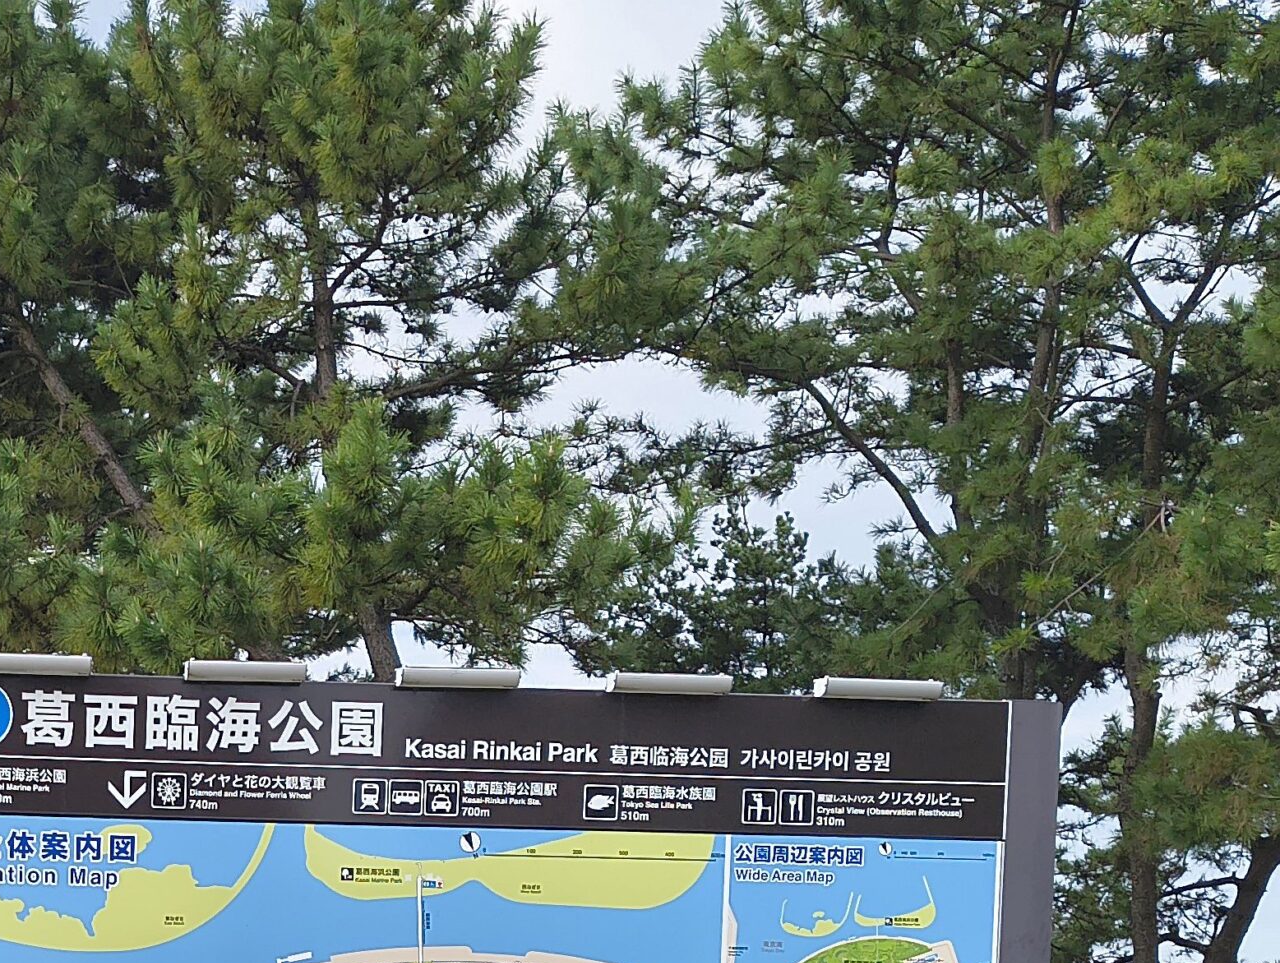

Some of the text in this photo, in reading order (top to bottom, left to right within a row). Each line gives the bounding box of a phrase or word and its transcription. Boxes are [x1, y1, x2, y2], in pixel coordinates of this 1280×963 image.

[21, 689, 384, 757] 葛西臨海公園
[404, 738, 597, 763] Kasai Rinkai Park
[609, 744, 729, 769] 葛西临海公园
[741, 748, 891, 773] 가사이린카이 공원
[8, 784, 37, 795] Marine
[39, 786, 51, 796] Park
[191, 773, 325, 791] ダイヤと花の大観覧車
[428, 783, 455, 793] TAXI
[462, 780, 558, 796] 葛西臨海公園駅
[189, 788, 312, 802] Diamond and Flower Ferris Wheel
[622, 784, 716, 801] 葛西臨海水族園
[878, 790, 975, 807] クリスタルビュー
[189, 800, 219, 811] 740m
[509, 798, 527, 806] Park
[621, 800, 693, 811] Tokyo Sea Life Park
[461, 807, 491, 818] 700m
[621, 811, 650, 821] 510m
[817, 806, 844, 816] Crystal
[846, 807, 864, 816] View
[816, 816, 845, 827] 310m
[735, 845, 864, 866] 公園周辺案内図
[70, 868, 119, 889] Map
[735, 868, 835, 884] Wide Area Map
